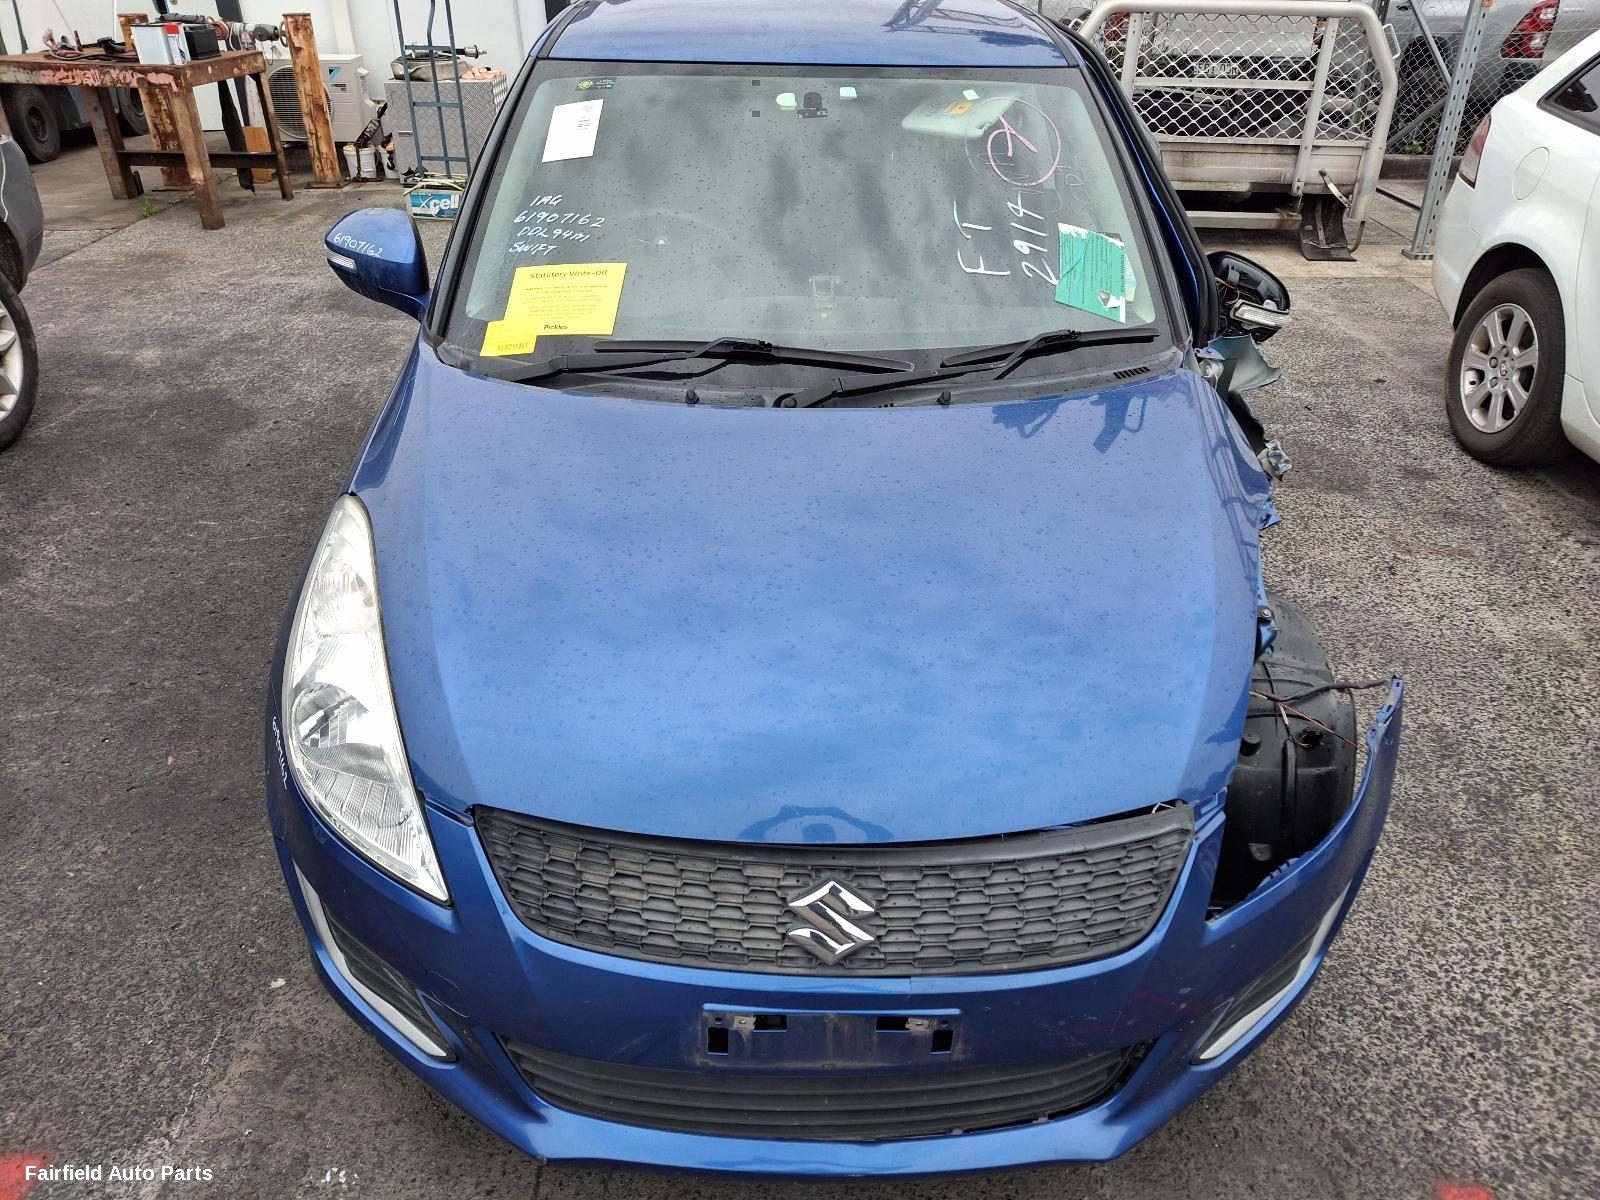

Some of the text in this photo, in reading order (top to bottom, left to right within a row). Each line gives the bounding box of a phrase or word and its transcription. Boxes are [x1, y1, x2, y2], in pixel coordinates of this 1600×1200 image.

[418, 195, 460, 210] Xcell
[513, 210, 605, 228] 61907162
[333, 232, 384, 258] 61907162
[508, 241, 558, 256] SWIFT
[530, 269, 609, 279] Statutory Write-Off
